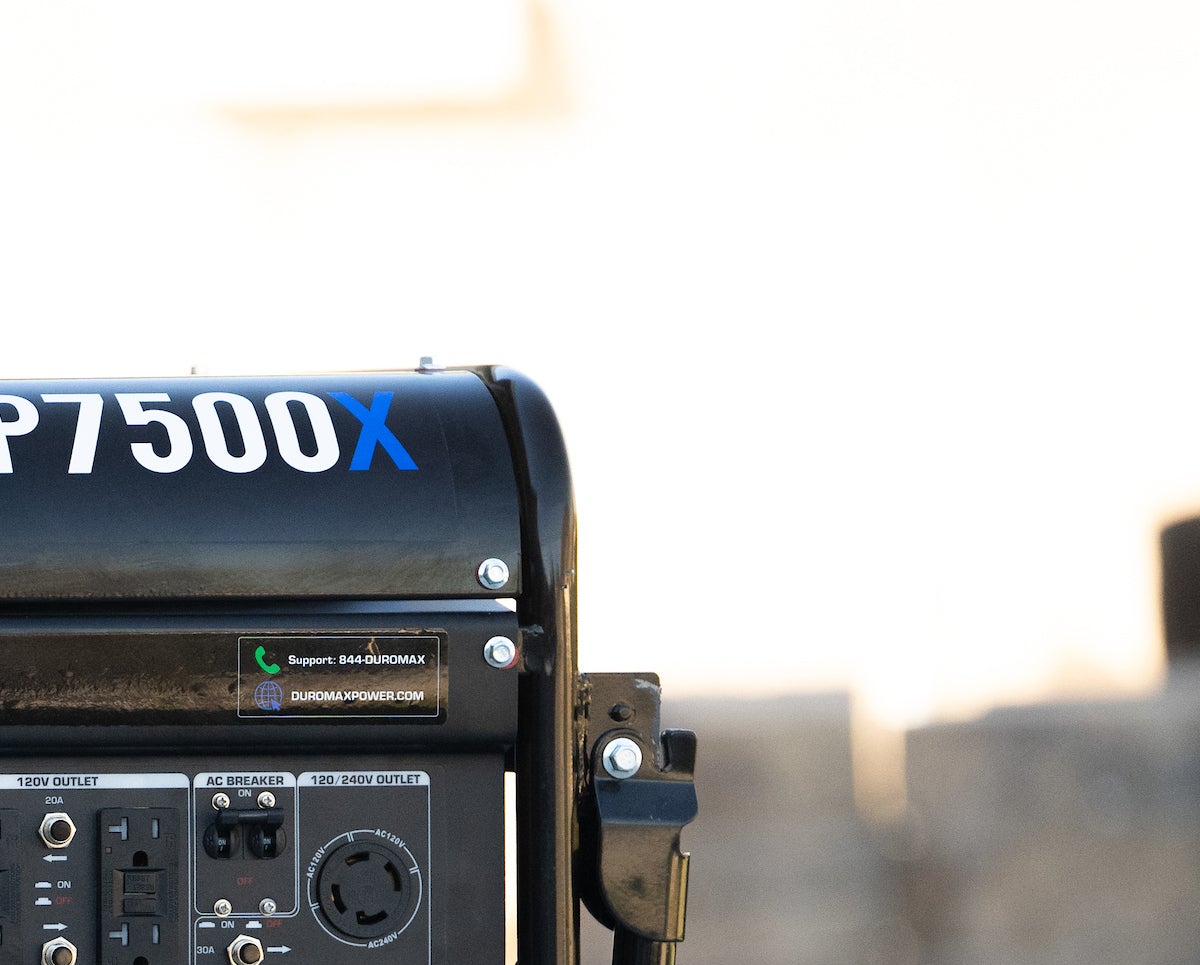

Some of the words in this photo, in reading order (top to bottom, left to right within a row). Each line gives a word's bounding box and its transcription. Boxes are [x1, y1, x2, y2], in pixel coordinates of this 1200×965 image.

[288, 654, 336, 668] Support:
[339, 653, 426, 666] 844-DUROMAX
[291, 690, 425, 702] DUROMAXPOWER.COM
[16, 777, 49, 787] 120V
[53, 776, 99, 786] OUTLET
[206, 777, 224, 786] AC
[226, 776, 285, 785] BREAKER
[311, 775, 373, 785] 120/240V
[376, 774, 420, 784] OUTLET
[238, 789, 252, 797] ON
[374, 829, 406, 848] AC120V
[306, 847, 326, 879] AC120V
[57, 881, 71, 889] ON
[221, 921, 235, 929] ON
[266, 920, 282, 928] OFF
[368, 932, 399, 949] AC240V
[196, 946, 215, 954] 30A
